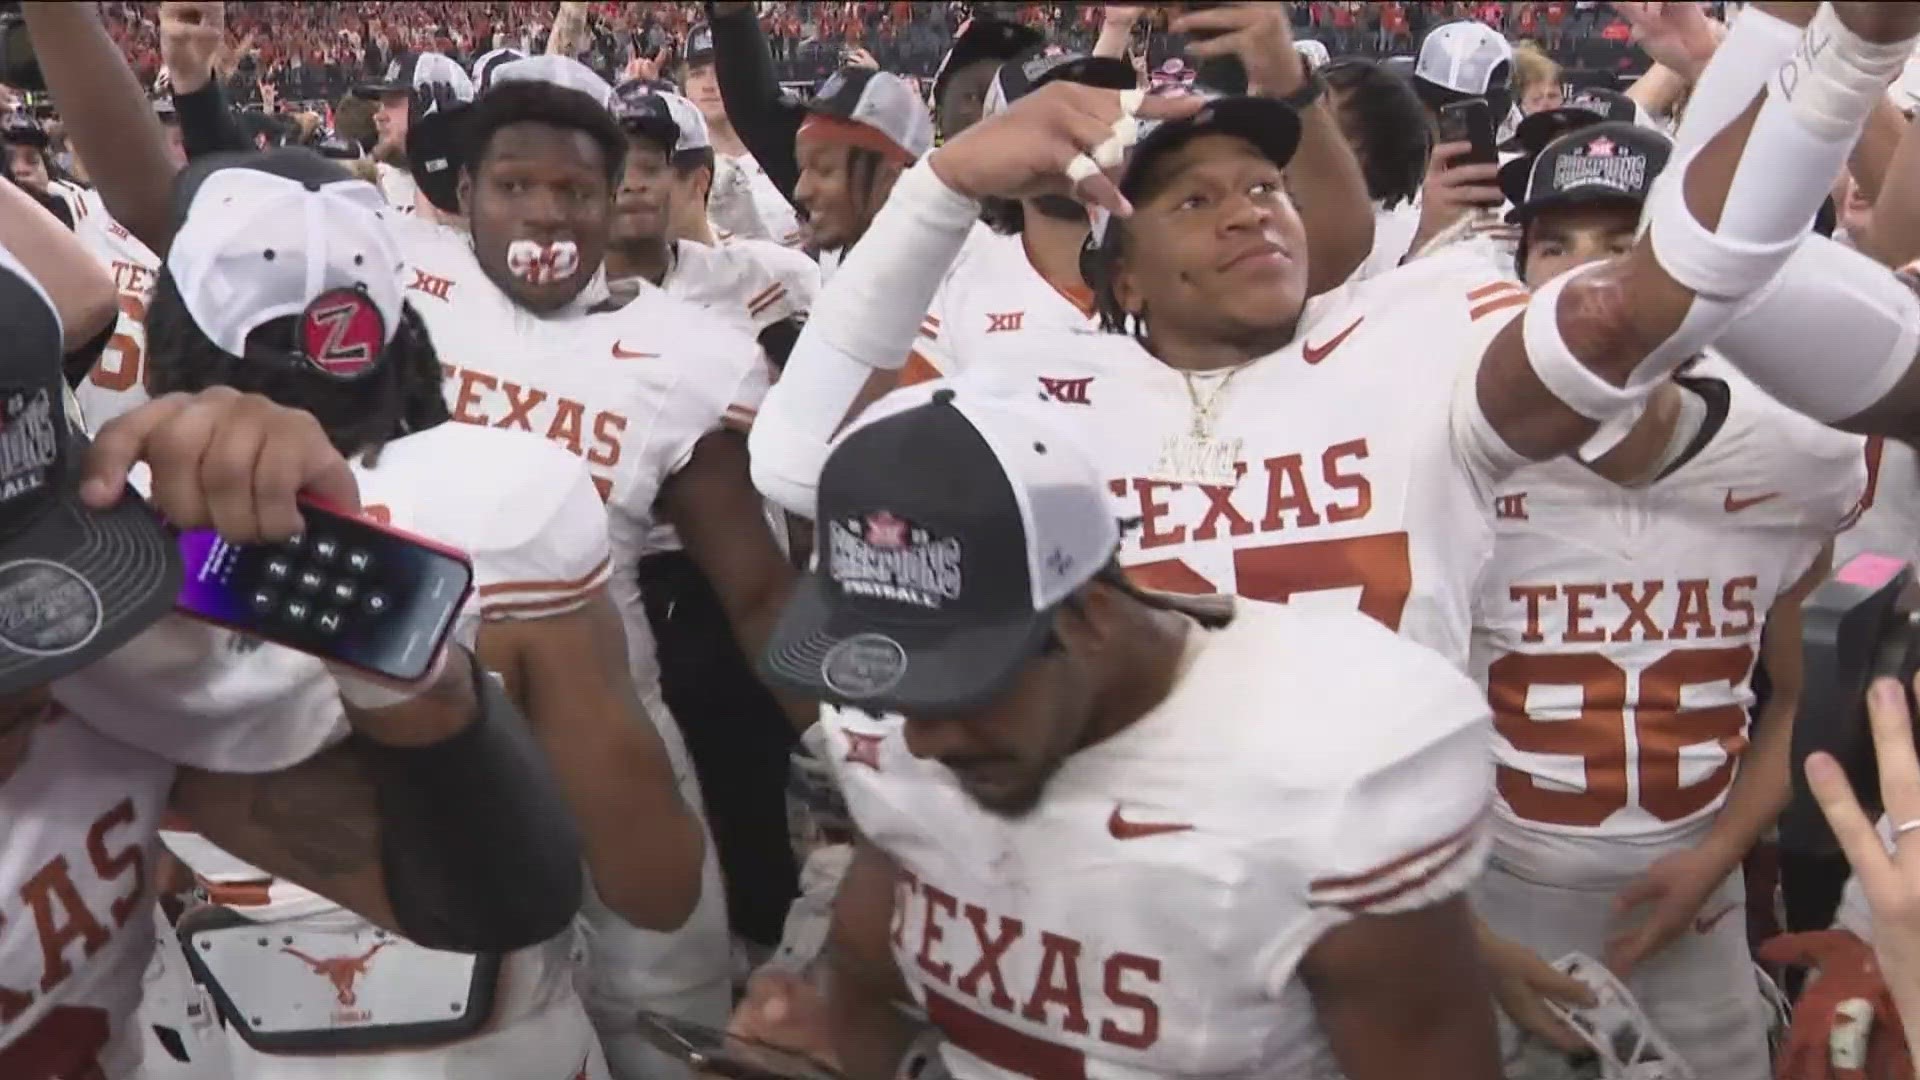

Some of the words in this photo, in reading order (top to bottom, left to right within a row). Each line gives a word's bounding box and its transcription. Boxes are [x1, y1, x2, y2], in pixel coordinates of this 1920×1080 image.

[112, 261, 160, 295] TE
[407, 268, 456, 303] XII
[312, 302, 372, 363] Z
[985, 311, 1024, 333] XII
[1038, 376, 1095, 406] XII
[1509, 576, 1757, 642] TEXAS
[1488, 647, 1757, 828] 96
[0, 797, 145, 1022] AS
